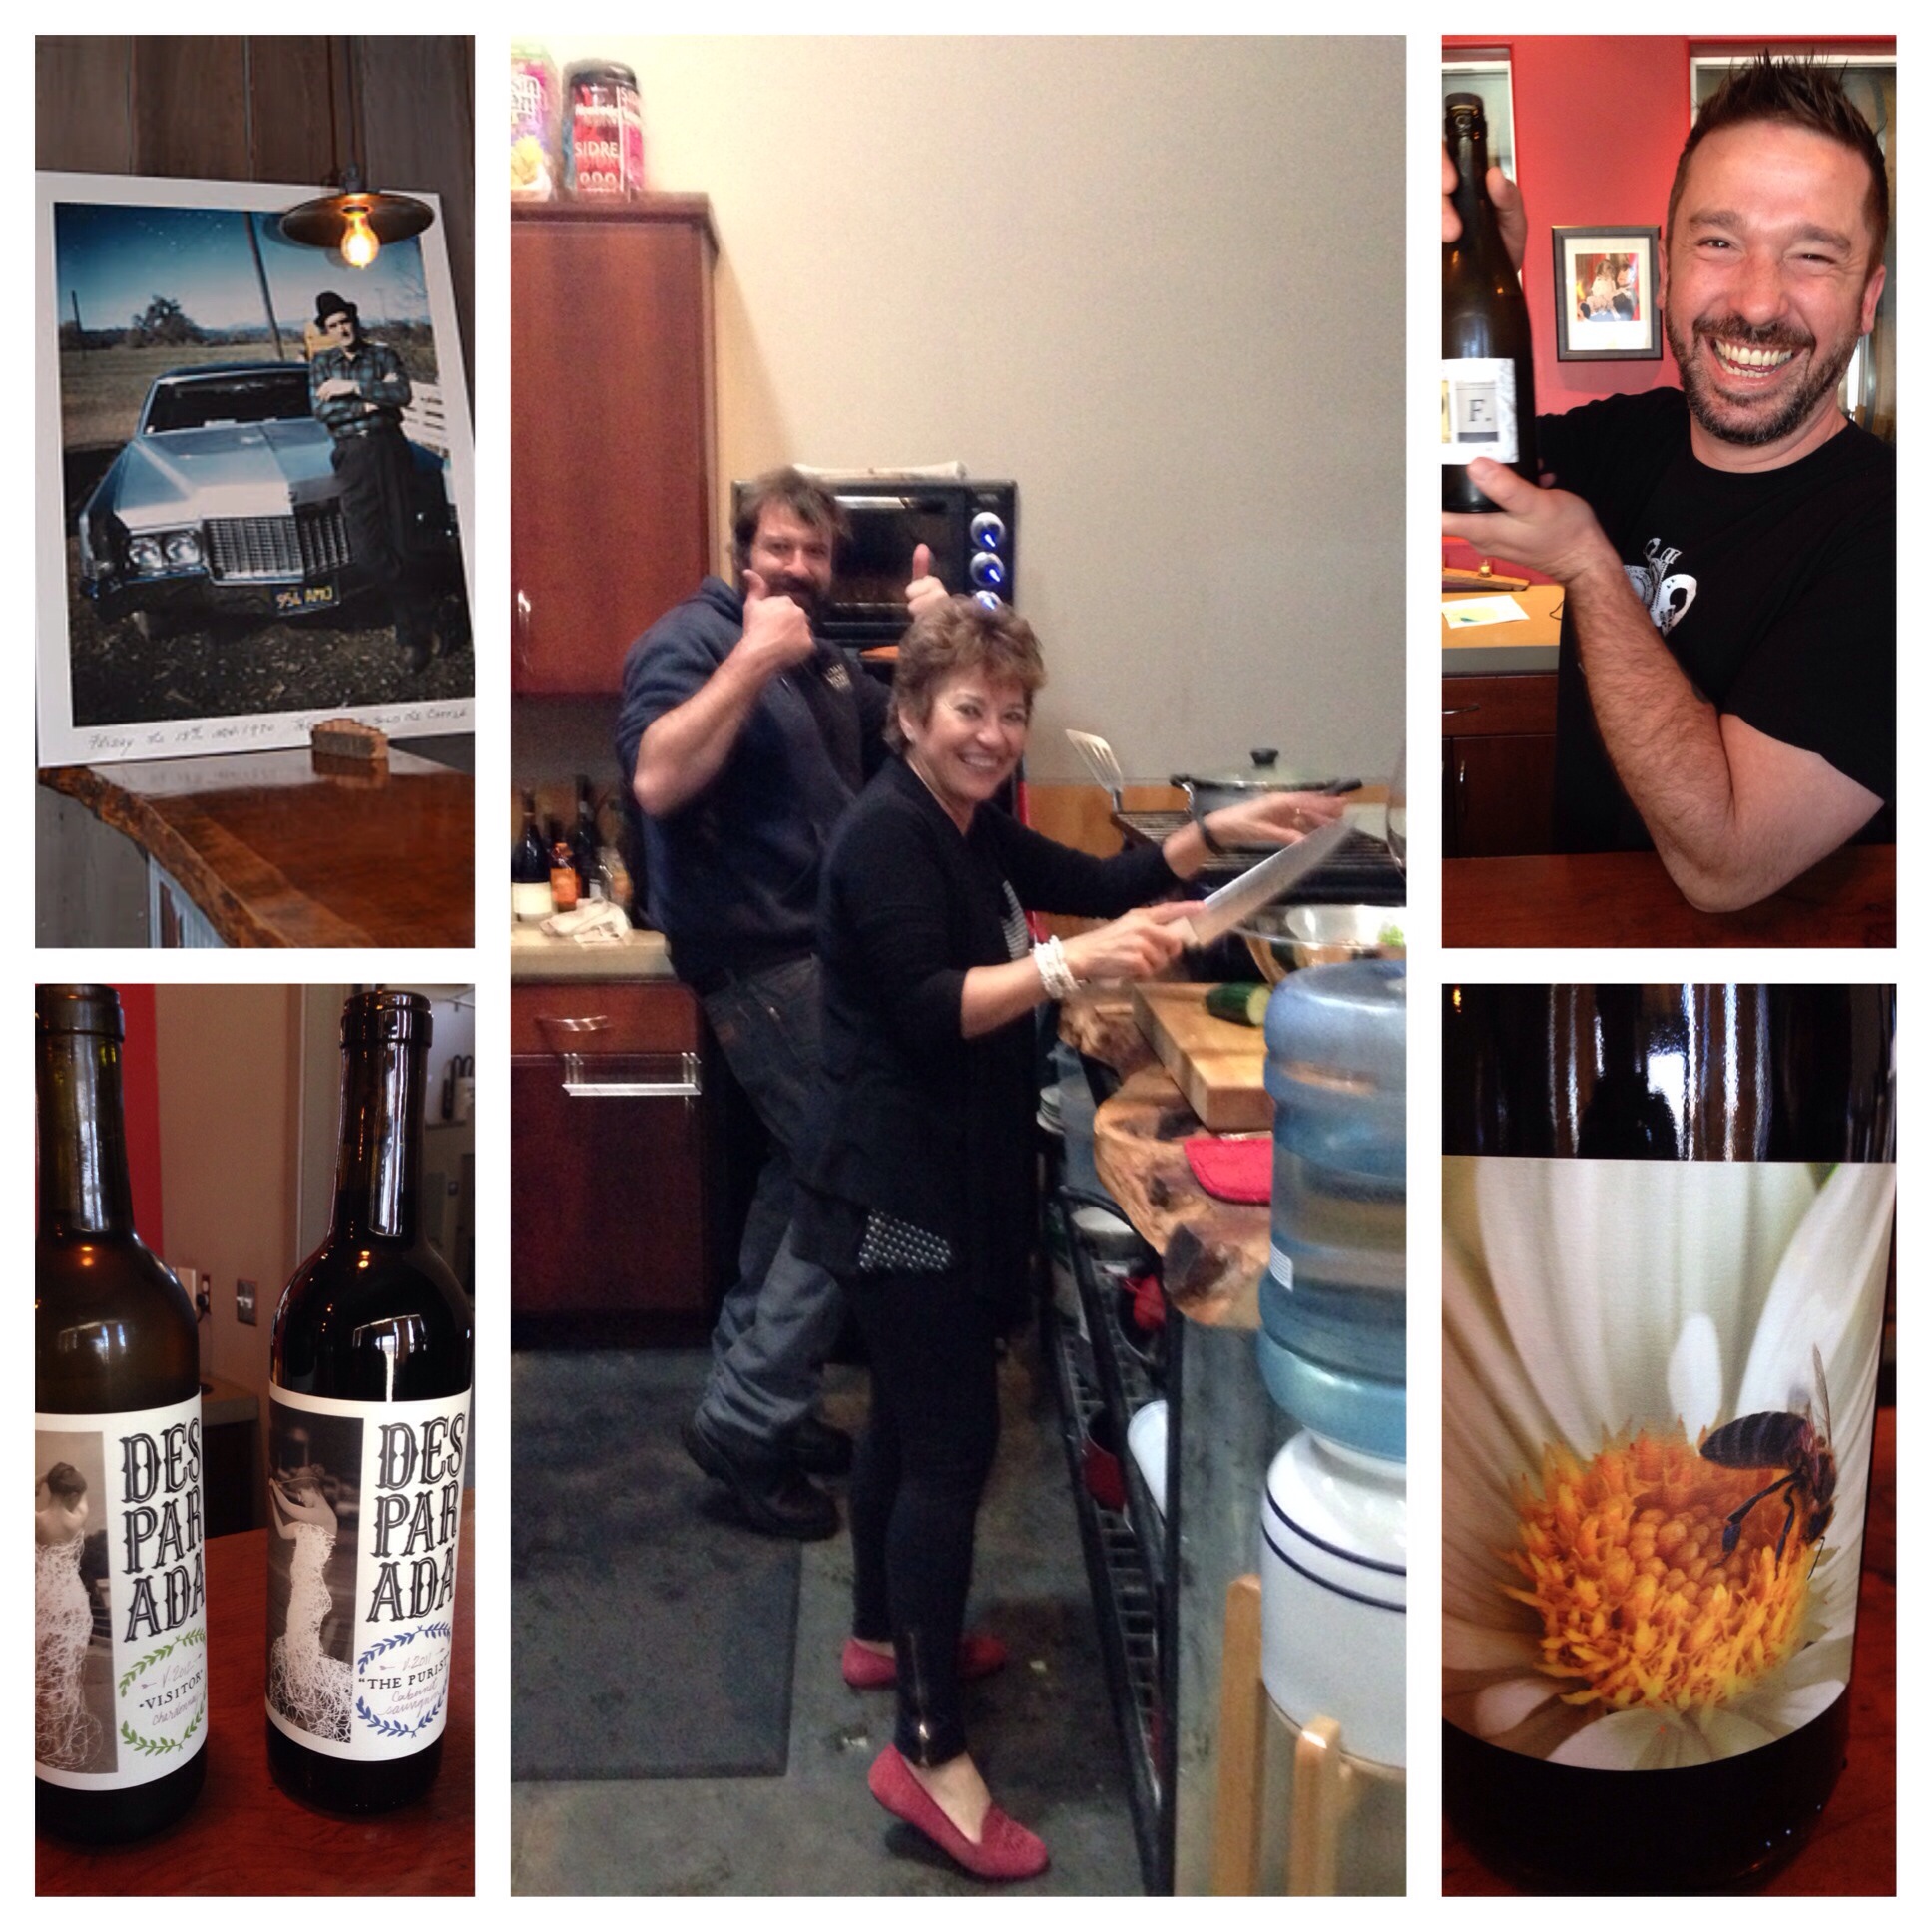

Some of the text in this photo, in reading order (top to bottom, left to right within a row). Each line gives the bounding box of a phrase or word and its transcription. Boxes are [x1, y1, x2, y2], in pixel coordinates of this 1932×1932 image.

[119, 1417, 201, 1504] DES
[374, 1412, 466, 1491] DES
[121, 1484, 203, 1575] PAR
[369, 1479, 459, 1558] PAR
[124, 1548, 206, 1643] ADA
[365, 1543, 456, 1623] ADA
